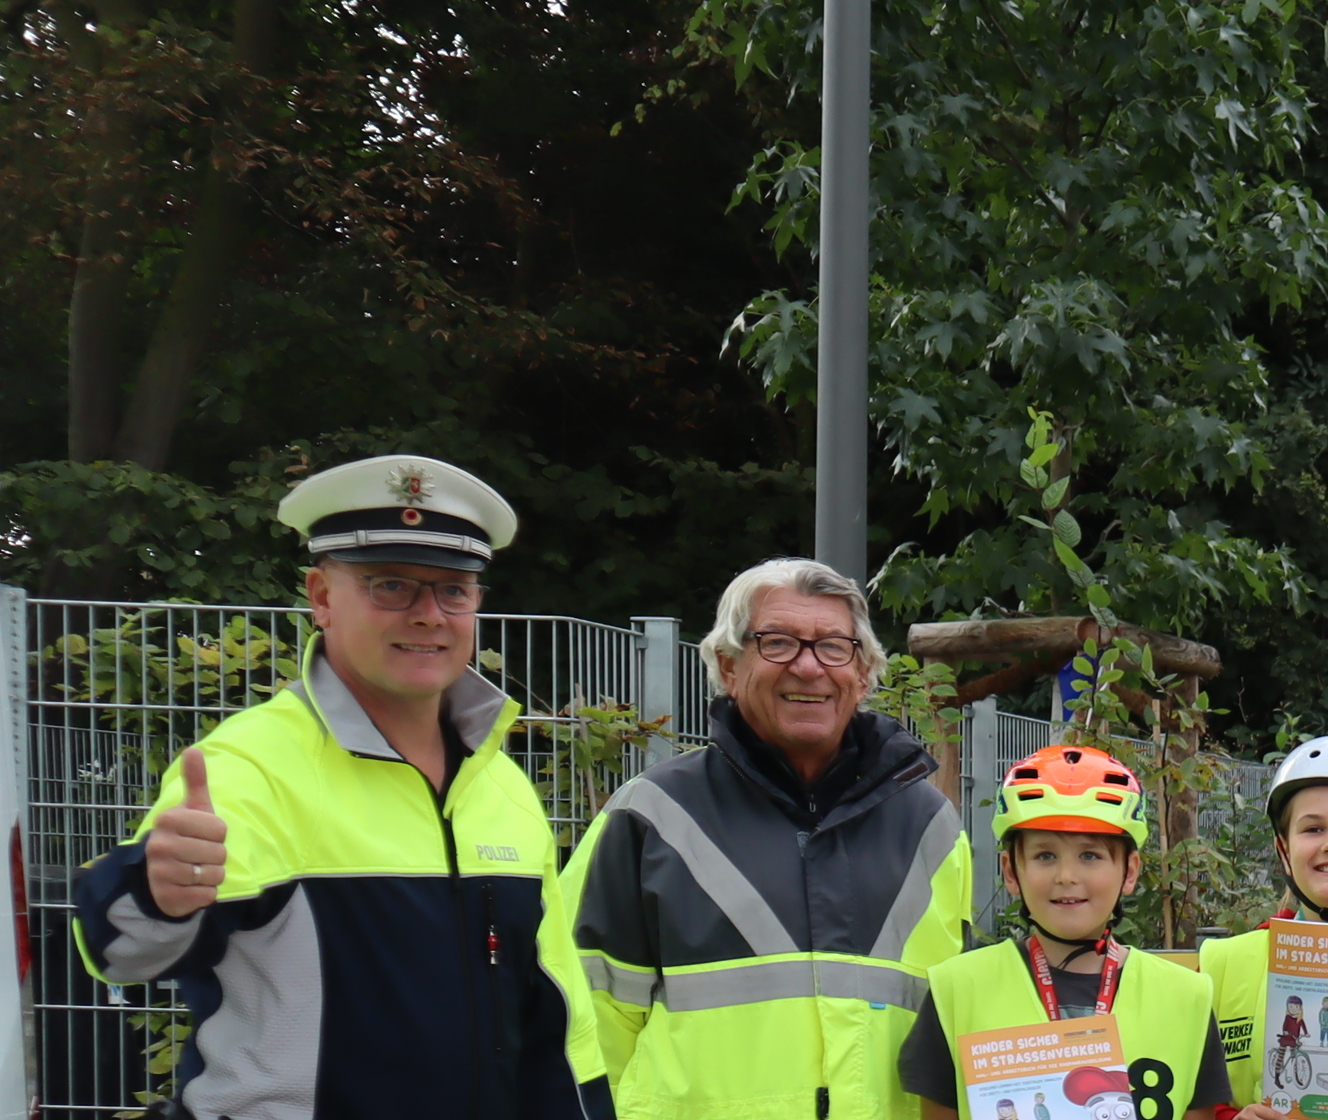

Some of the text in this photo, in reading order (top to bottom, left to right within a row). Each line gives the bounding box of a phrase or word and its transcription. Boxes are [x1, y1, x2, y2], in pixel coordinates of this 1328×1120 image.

[475, 844, 519, 862] POLIZEI
[1277, 933, 1315, 948] KINDER
[1276, 947, 1289, 960] IM
[971, 1033, 1059, 1055] KINDER SICHER
[973, 1041, 1111, 1069] IM STRASSENVERKEHR
[1272, 1098, 1289, 1109] AR
